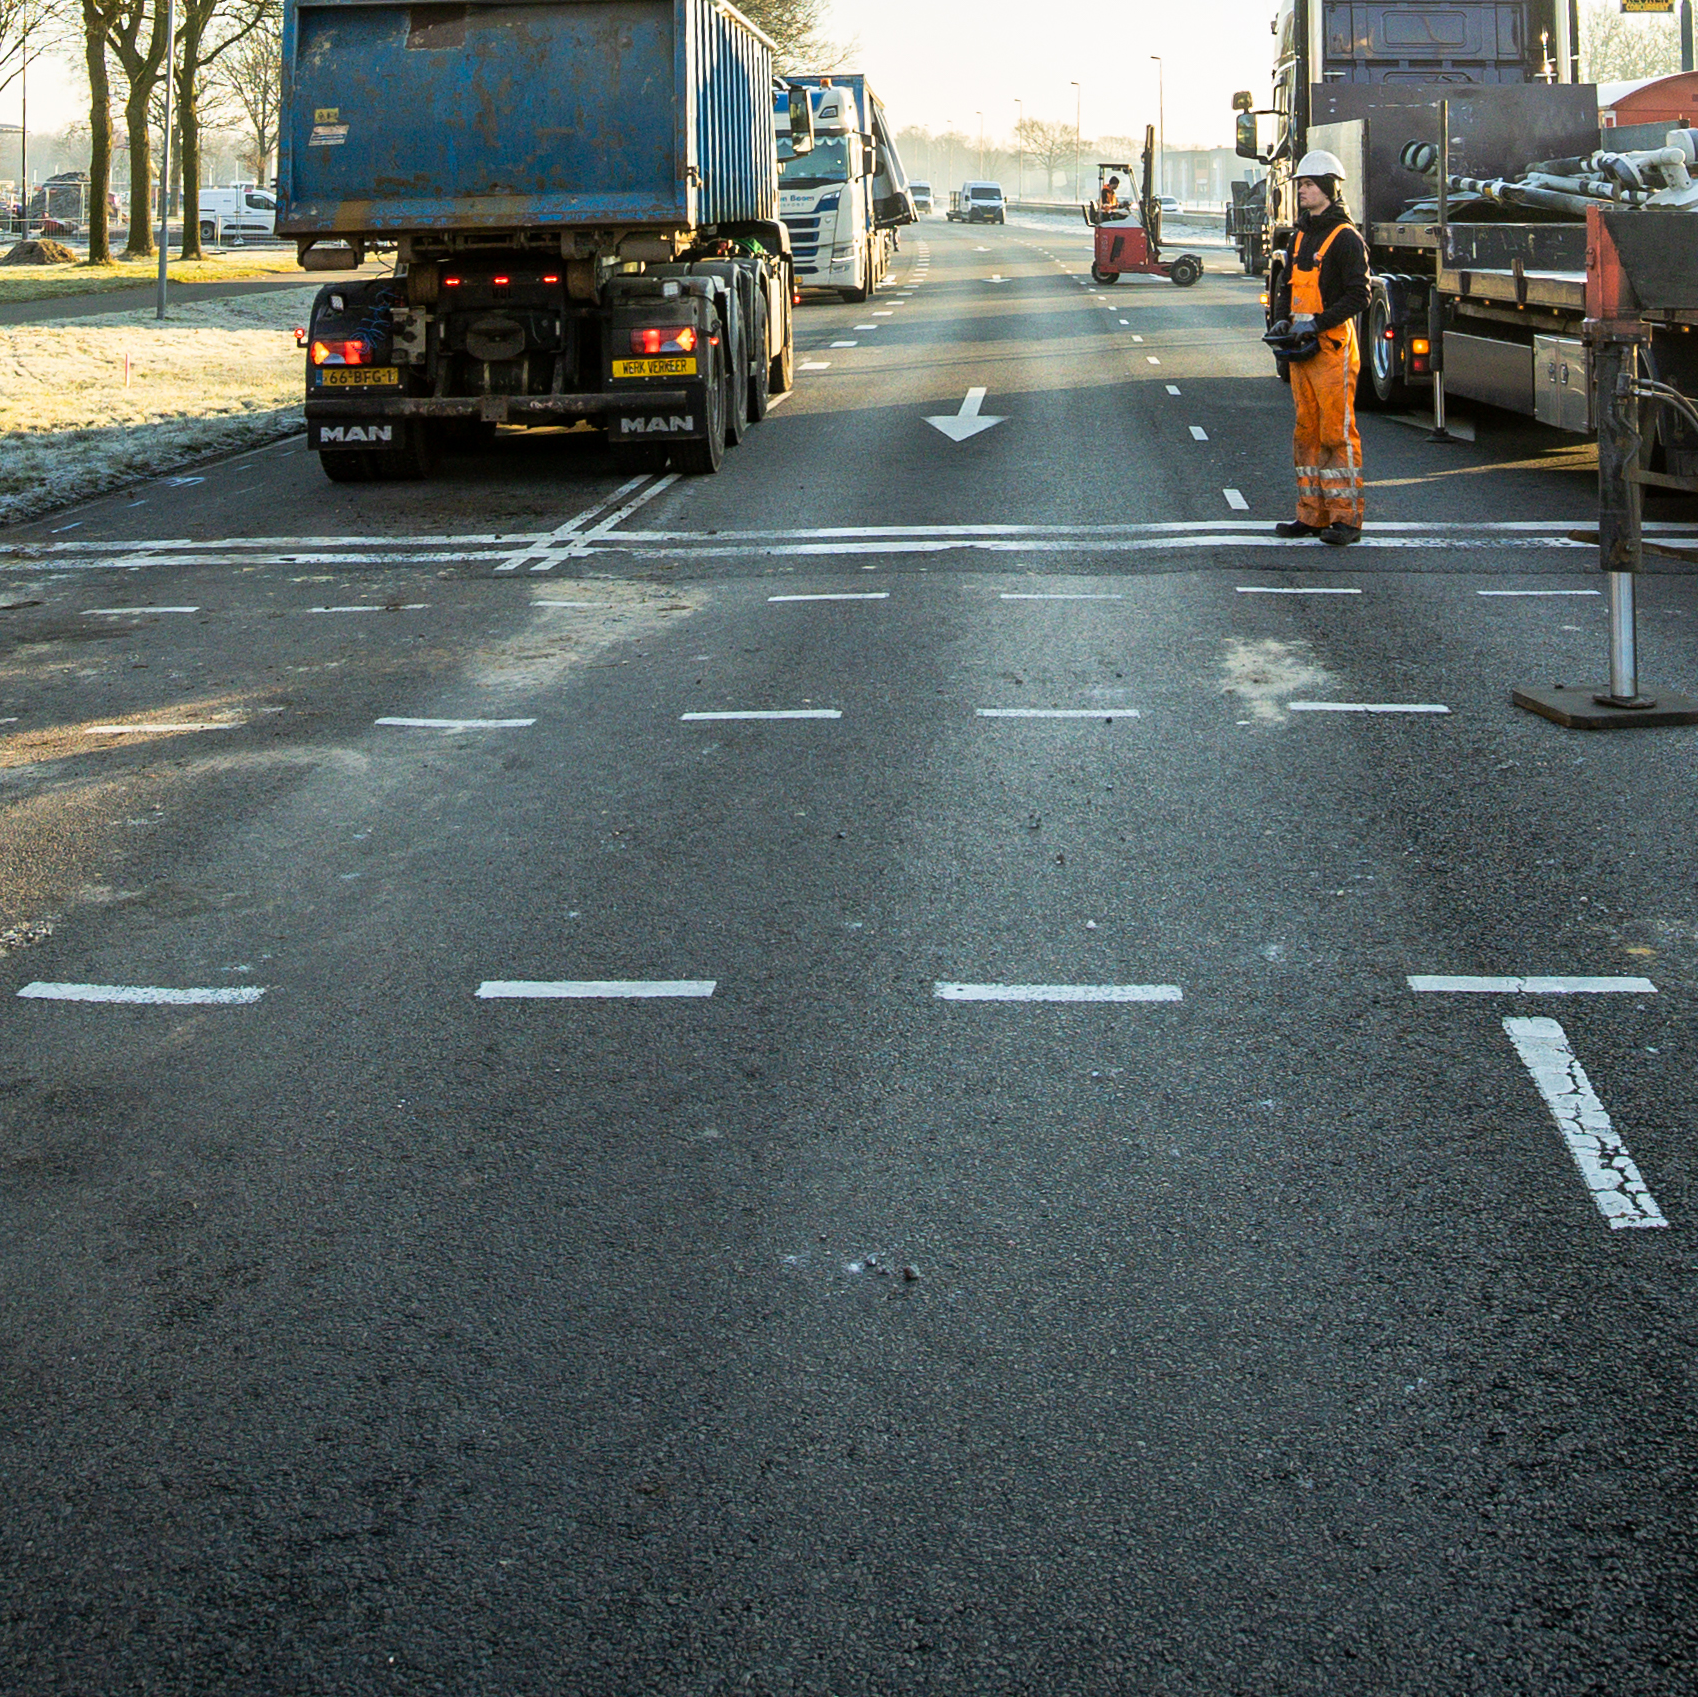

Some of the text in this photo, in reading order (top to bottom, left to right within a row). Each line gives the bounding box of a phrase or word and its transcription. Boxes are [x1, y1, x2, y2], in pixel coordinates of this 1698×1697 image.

[623, 359, 687, 375] WERK VERKEER
[329, 369, 393, 384] 66-BFG-1
[620, 415, 694, 433] MAN
[320, 425, 393, 442] MAN
